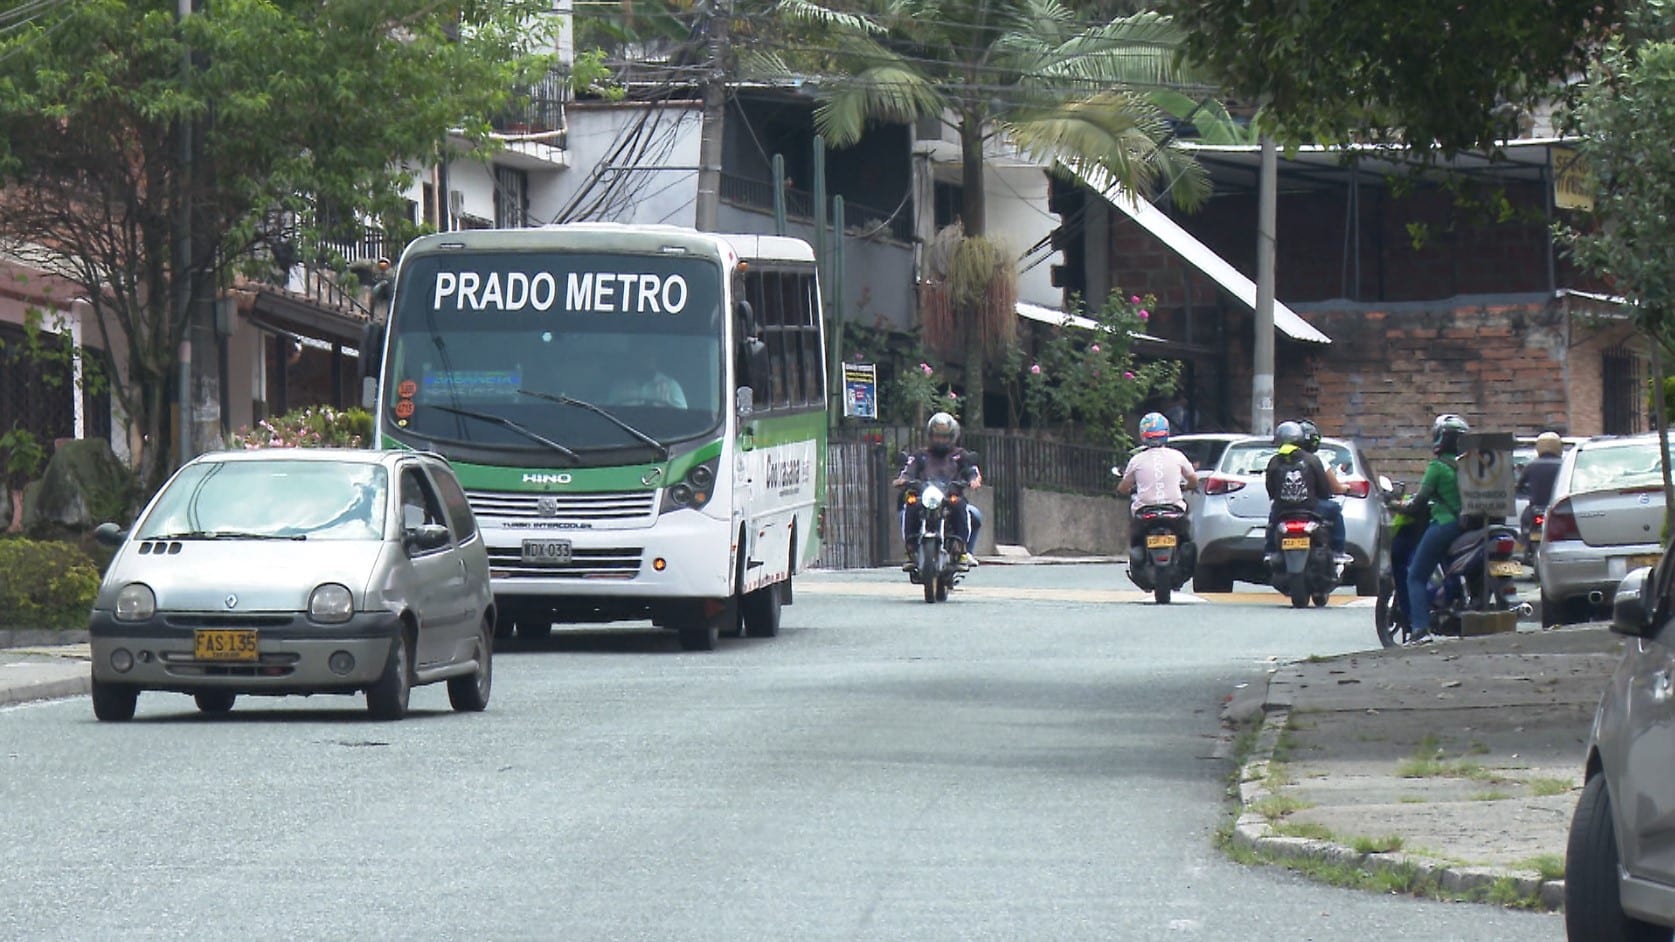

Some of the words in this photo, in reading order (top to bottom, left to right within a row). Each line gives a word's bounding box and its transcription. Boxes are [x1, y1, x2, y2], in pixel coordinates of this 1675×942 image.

[434, 271, 556, 311] PRADO
[565, 272, 688, 314] METRO
[522, 473, 572, 484] HINO
[196, 634, 224, 651] FAS
[229, 634, 256, 651] 135
